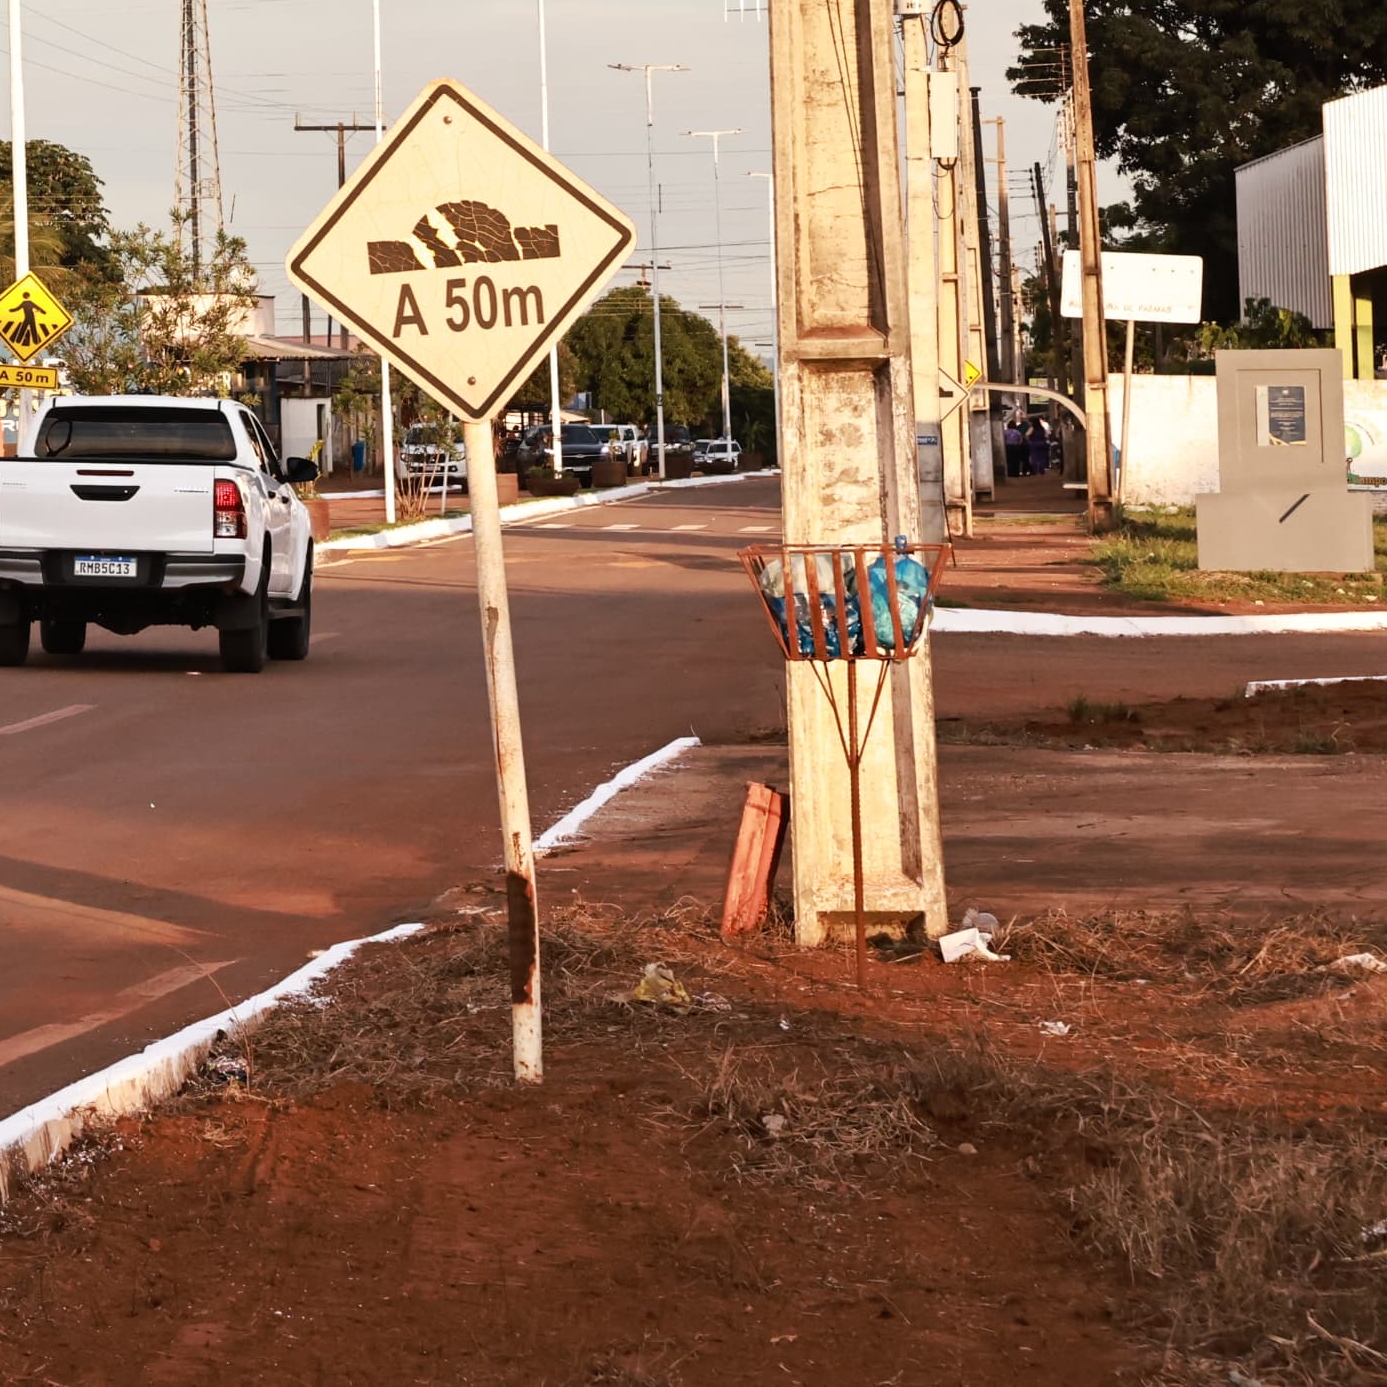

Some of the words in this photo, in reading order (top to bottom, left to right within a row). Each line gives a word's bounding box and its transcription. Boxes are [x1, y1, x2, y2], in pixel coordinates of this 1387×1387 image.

[392, 283, 429, 338] A
[445, 275, 545, 333] 50m
[80, 562, 130, 575] RMB5C13
